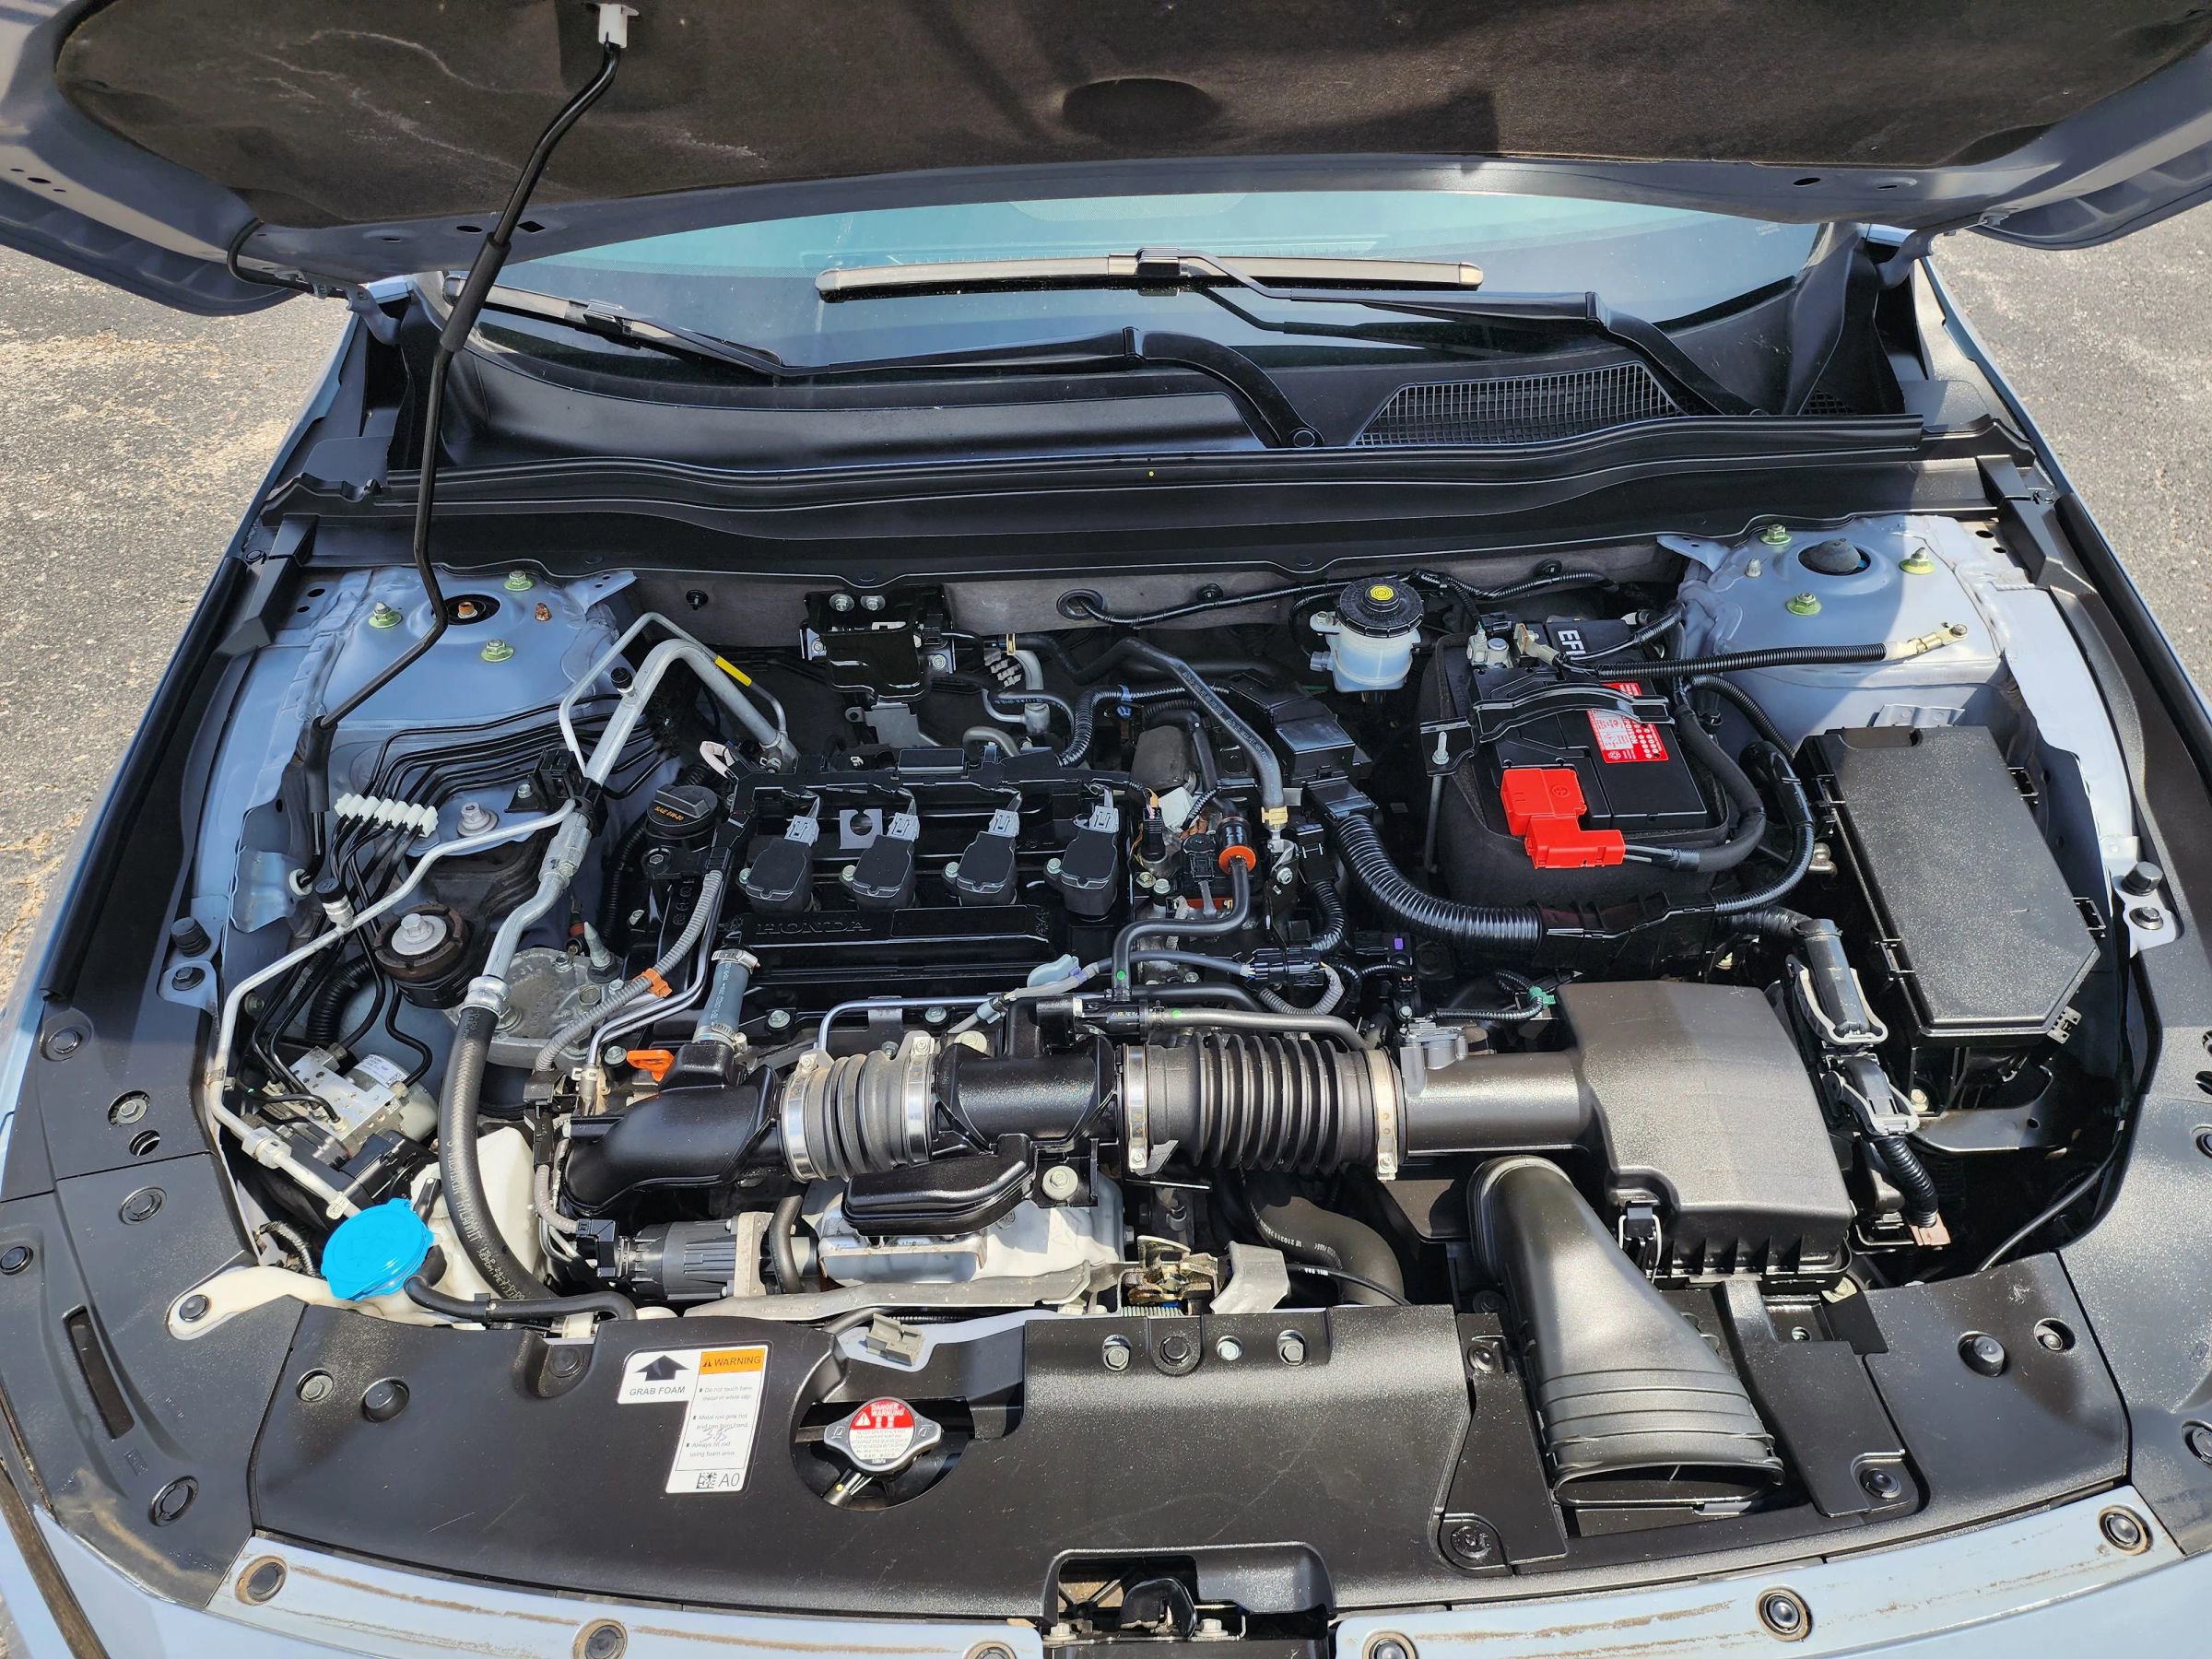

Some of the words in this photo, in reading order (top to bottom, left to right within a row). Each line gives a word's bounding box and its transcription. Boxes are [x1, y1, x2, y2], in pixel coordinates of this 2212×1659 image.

[756, 922, 871, 935] HONDA
[714, 1356, 761, 1367] WARNING
[629, 1387, 656, 1396] GRAB
[658, 1385, 686, 1394] FOAM
